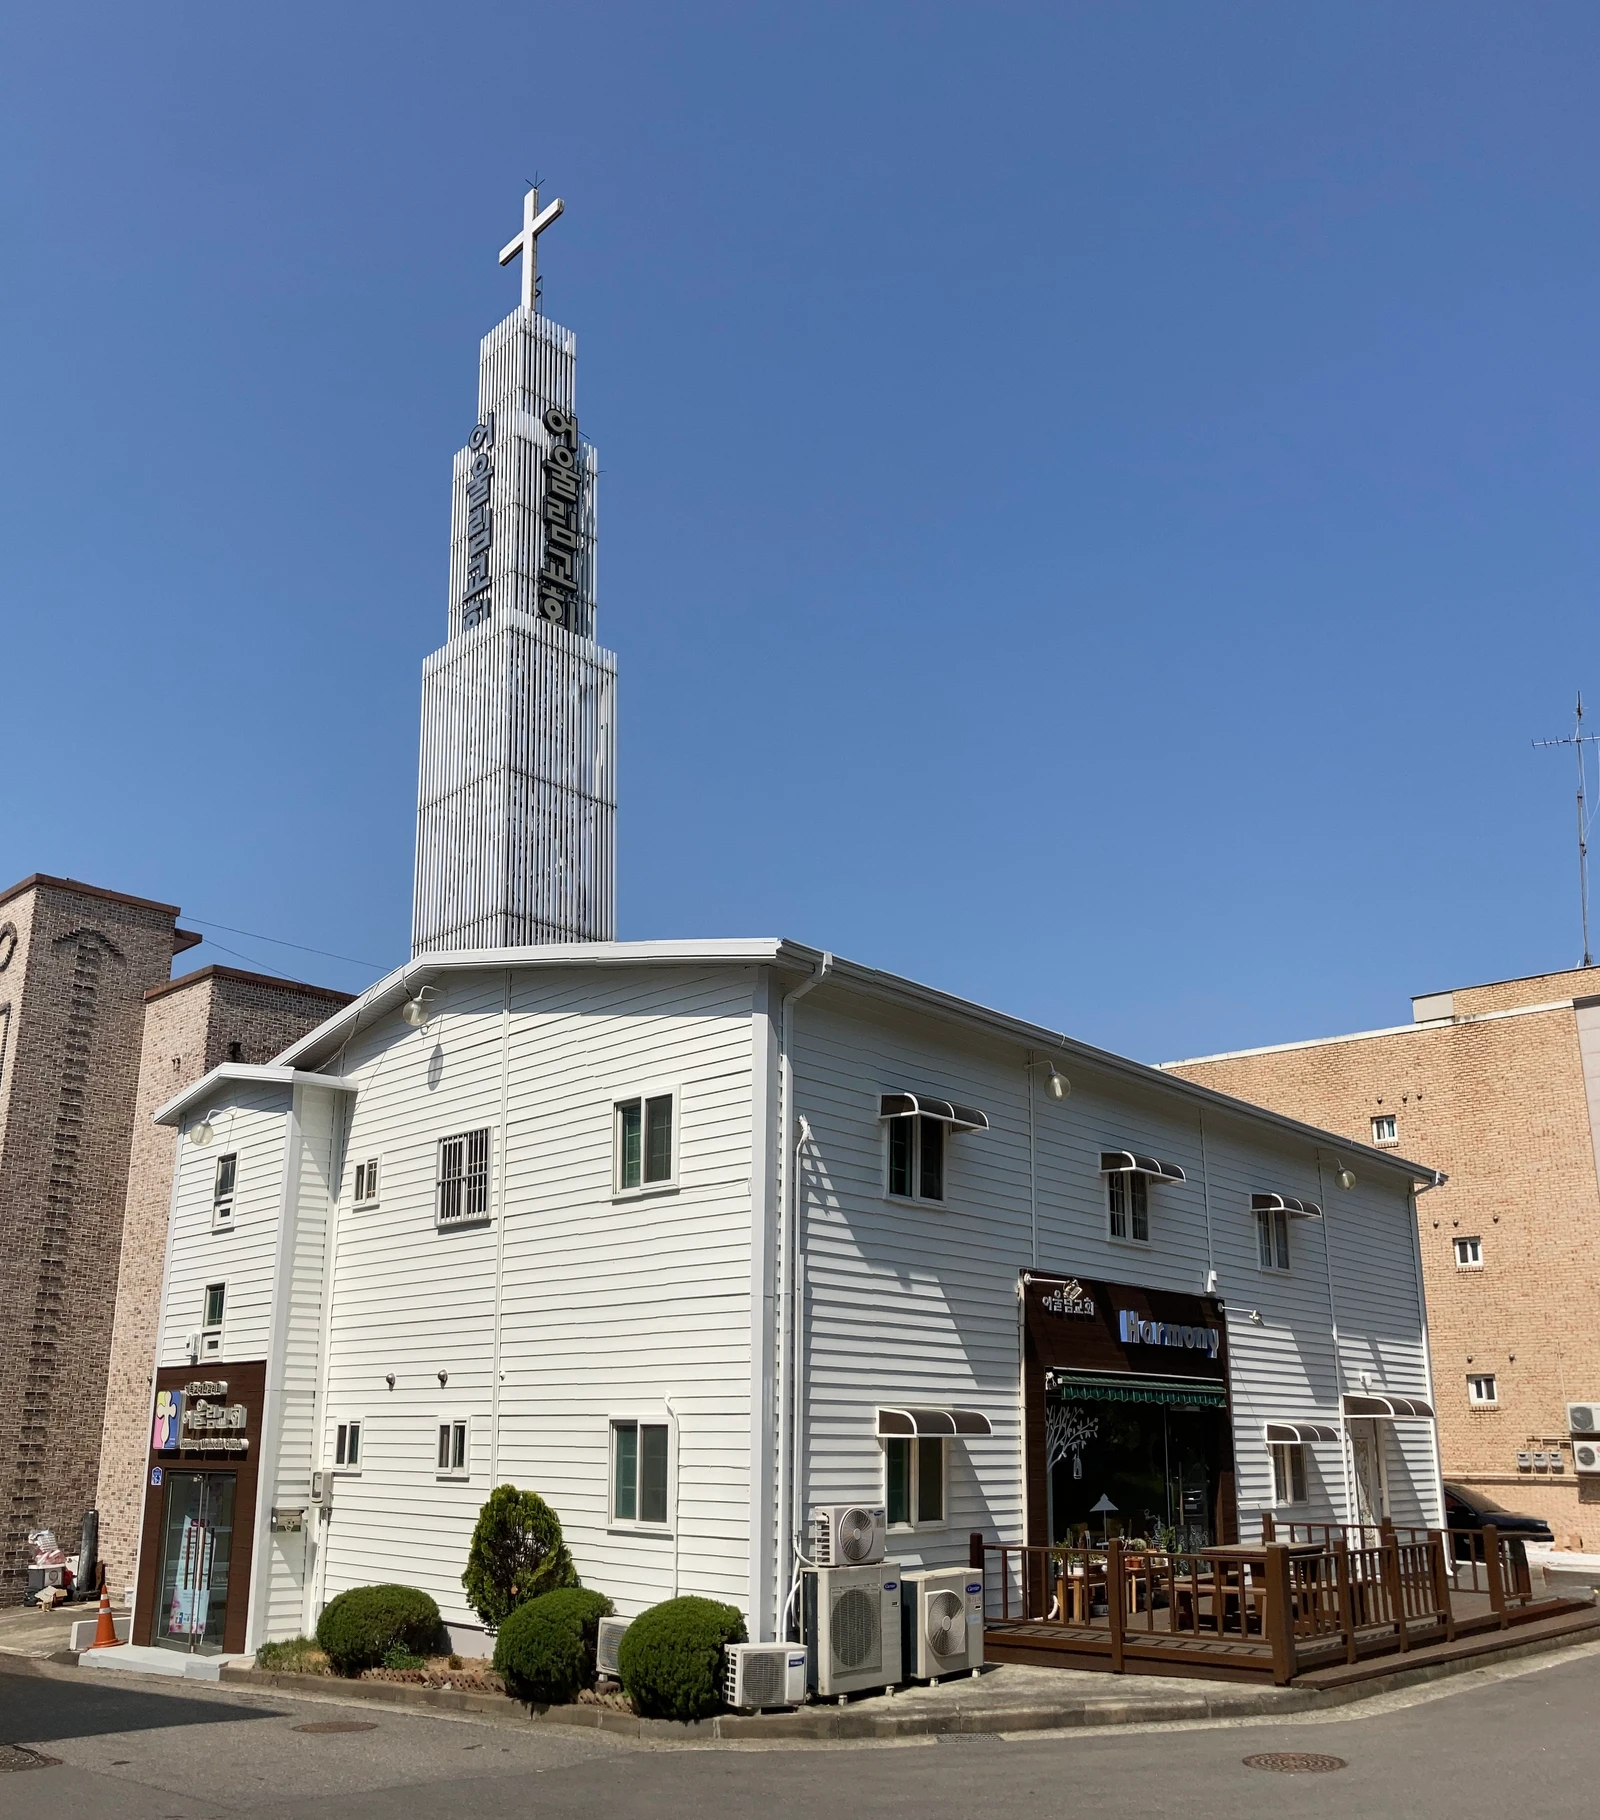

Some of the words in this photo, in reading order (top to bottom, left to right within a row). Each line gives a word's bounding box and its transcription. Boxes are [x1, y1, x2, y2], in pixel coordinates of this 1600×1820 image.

[464, 413, 494, 631] 어울림교회
[540, 409, 581, 631] 어울림교회
[1118, 1309, 1220, 1359] Harmony
[182, 1398, 247, 1429] 어울림교회
[225, 1438, 247, 1450] Church
